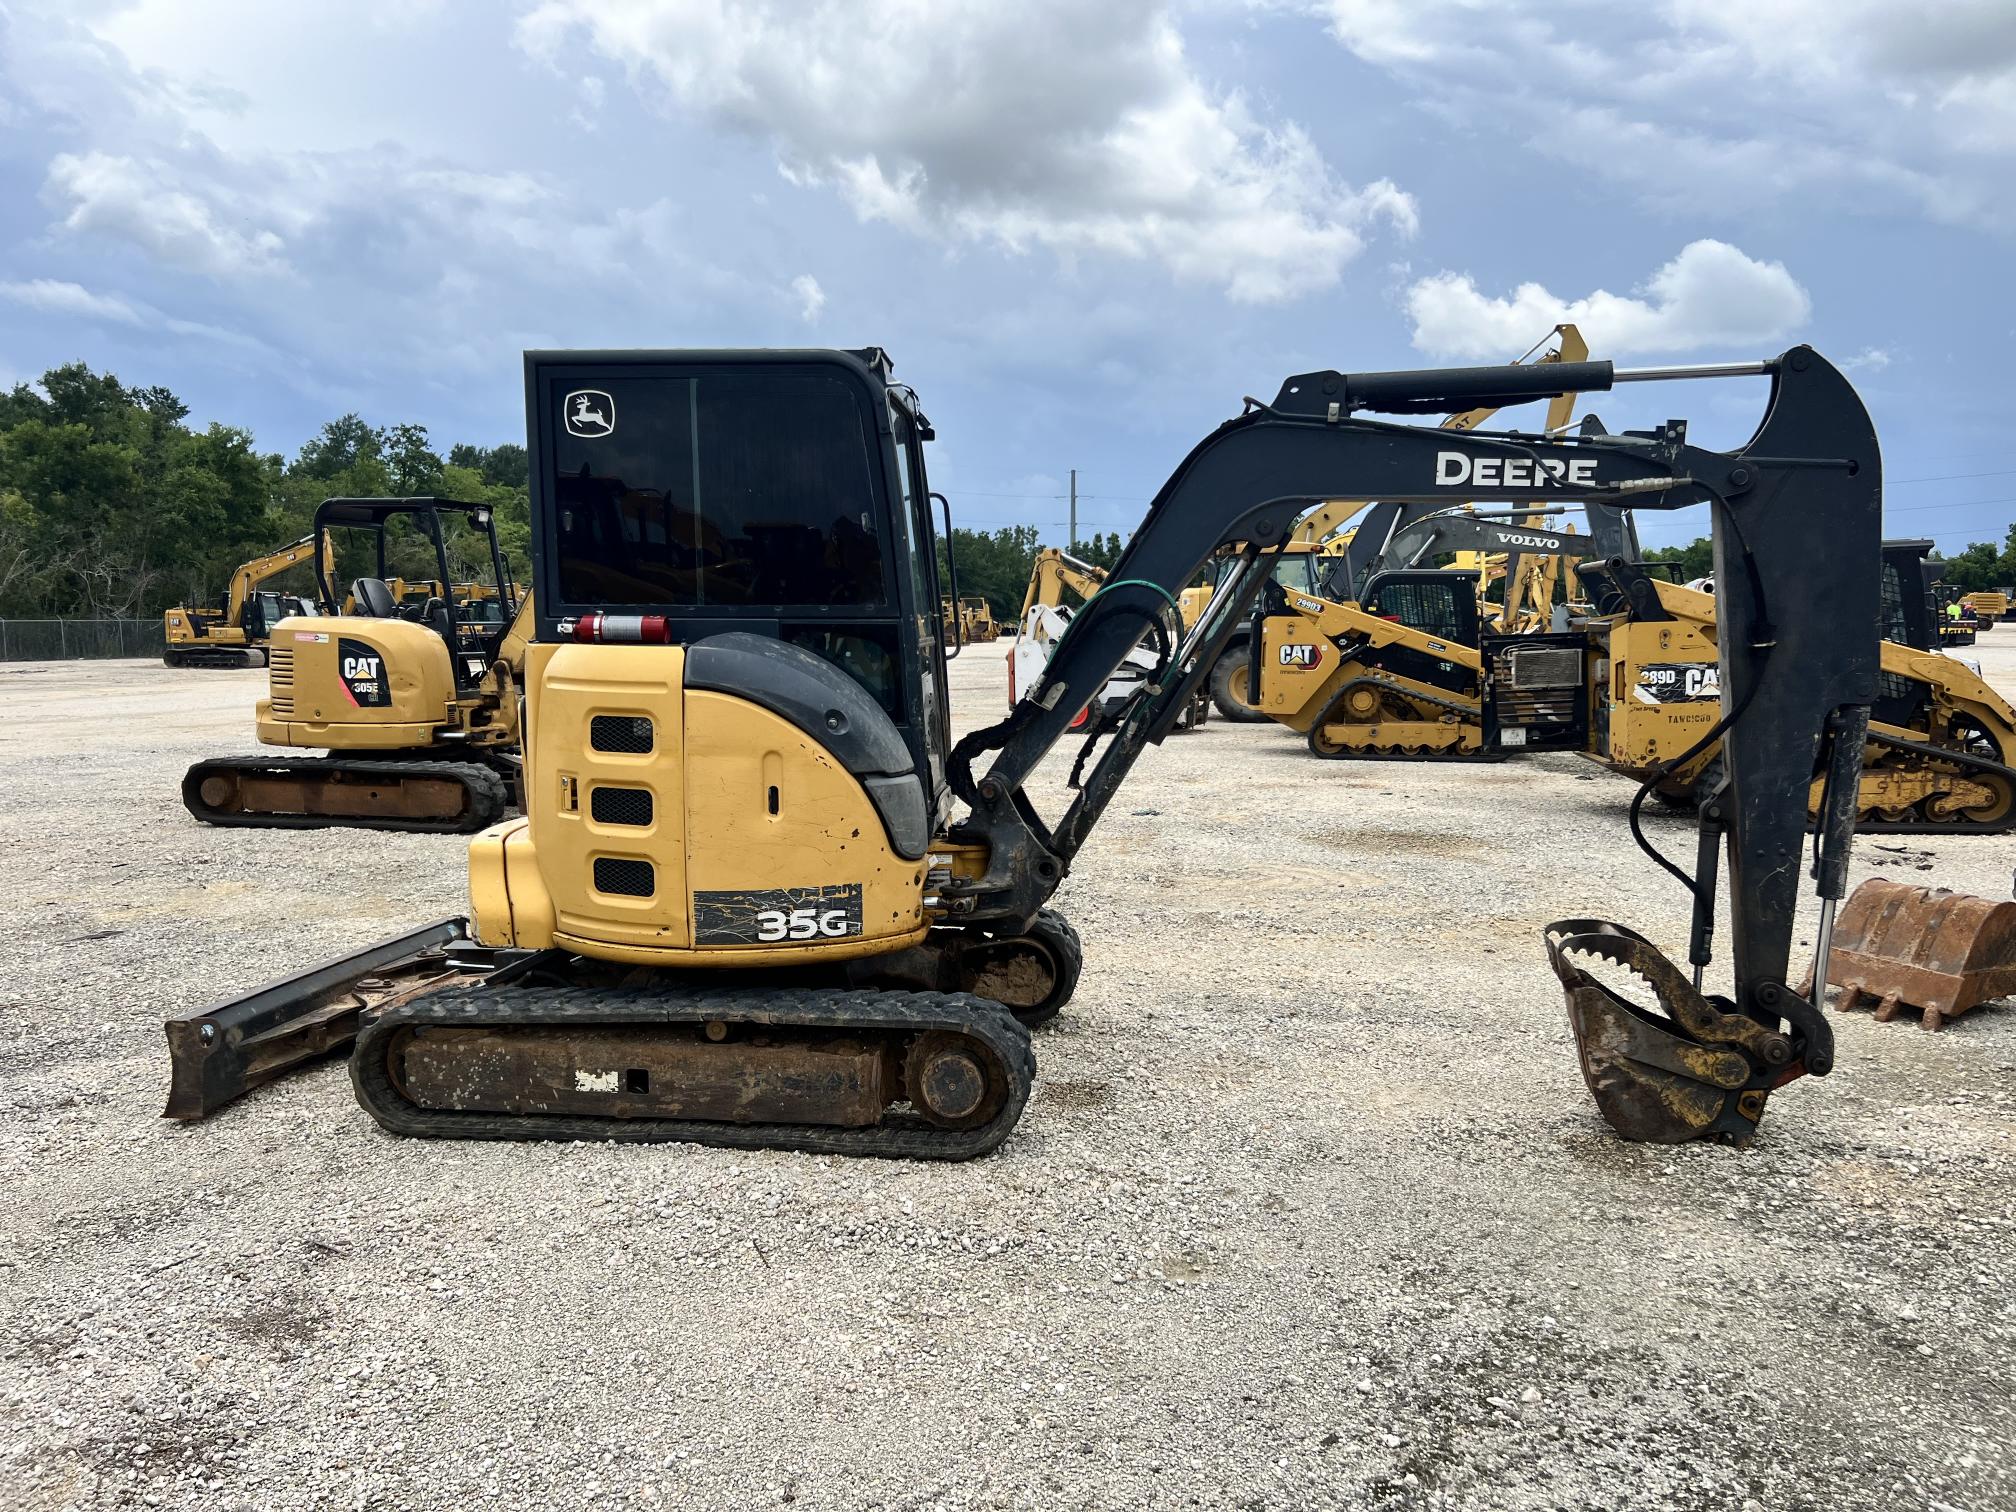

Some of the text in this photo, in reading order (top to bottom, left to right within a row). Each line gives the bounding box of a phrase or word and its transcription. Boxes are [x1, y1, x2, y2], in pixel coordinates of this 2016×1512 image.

[1436, 451, 1598, 487] DEERE
[1496, 533, 1560, 549] VOLVO
[1280, 645, 1313, 665] CAT
[344, 657, 380, 679] CAT
[353, 682, 379, 692] 305E
[757, 908, 847, 941] 35G
